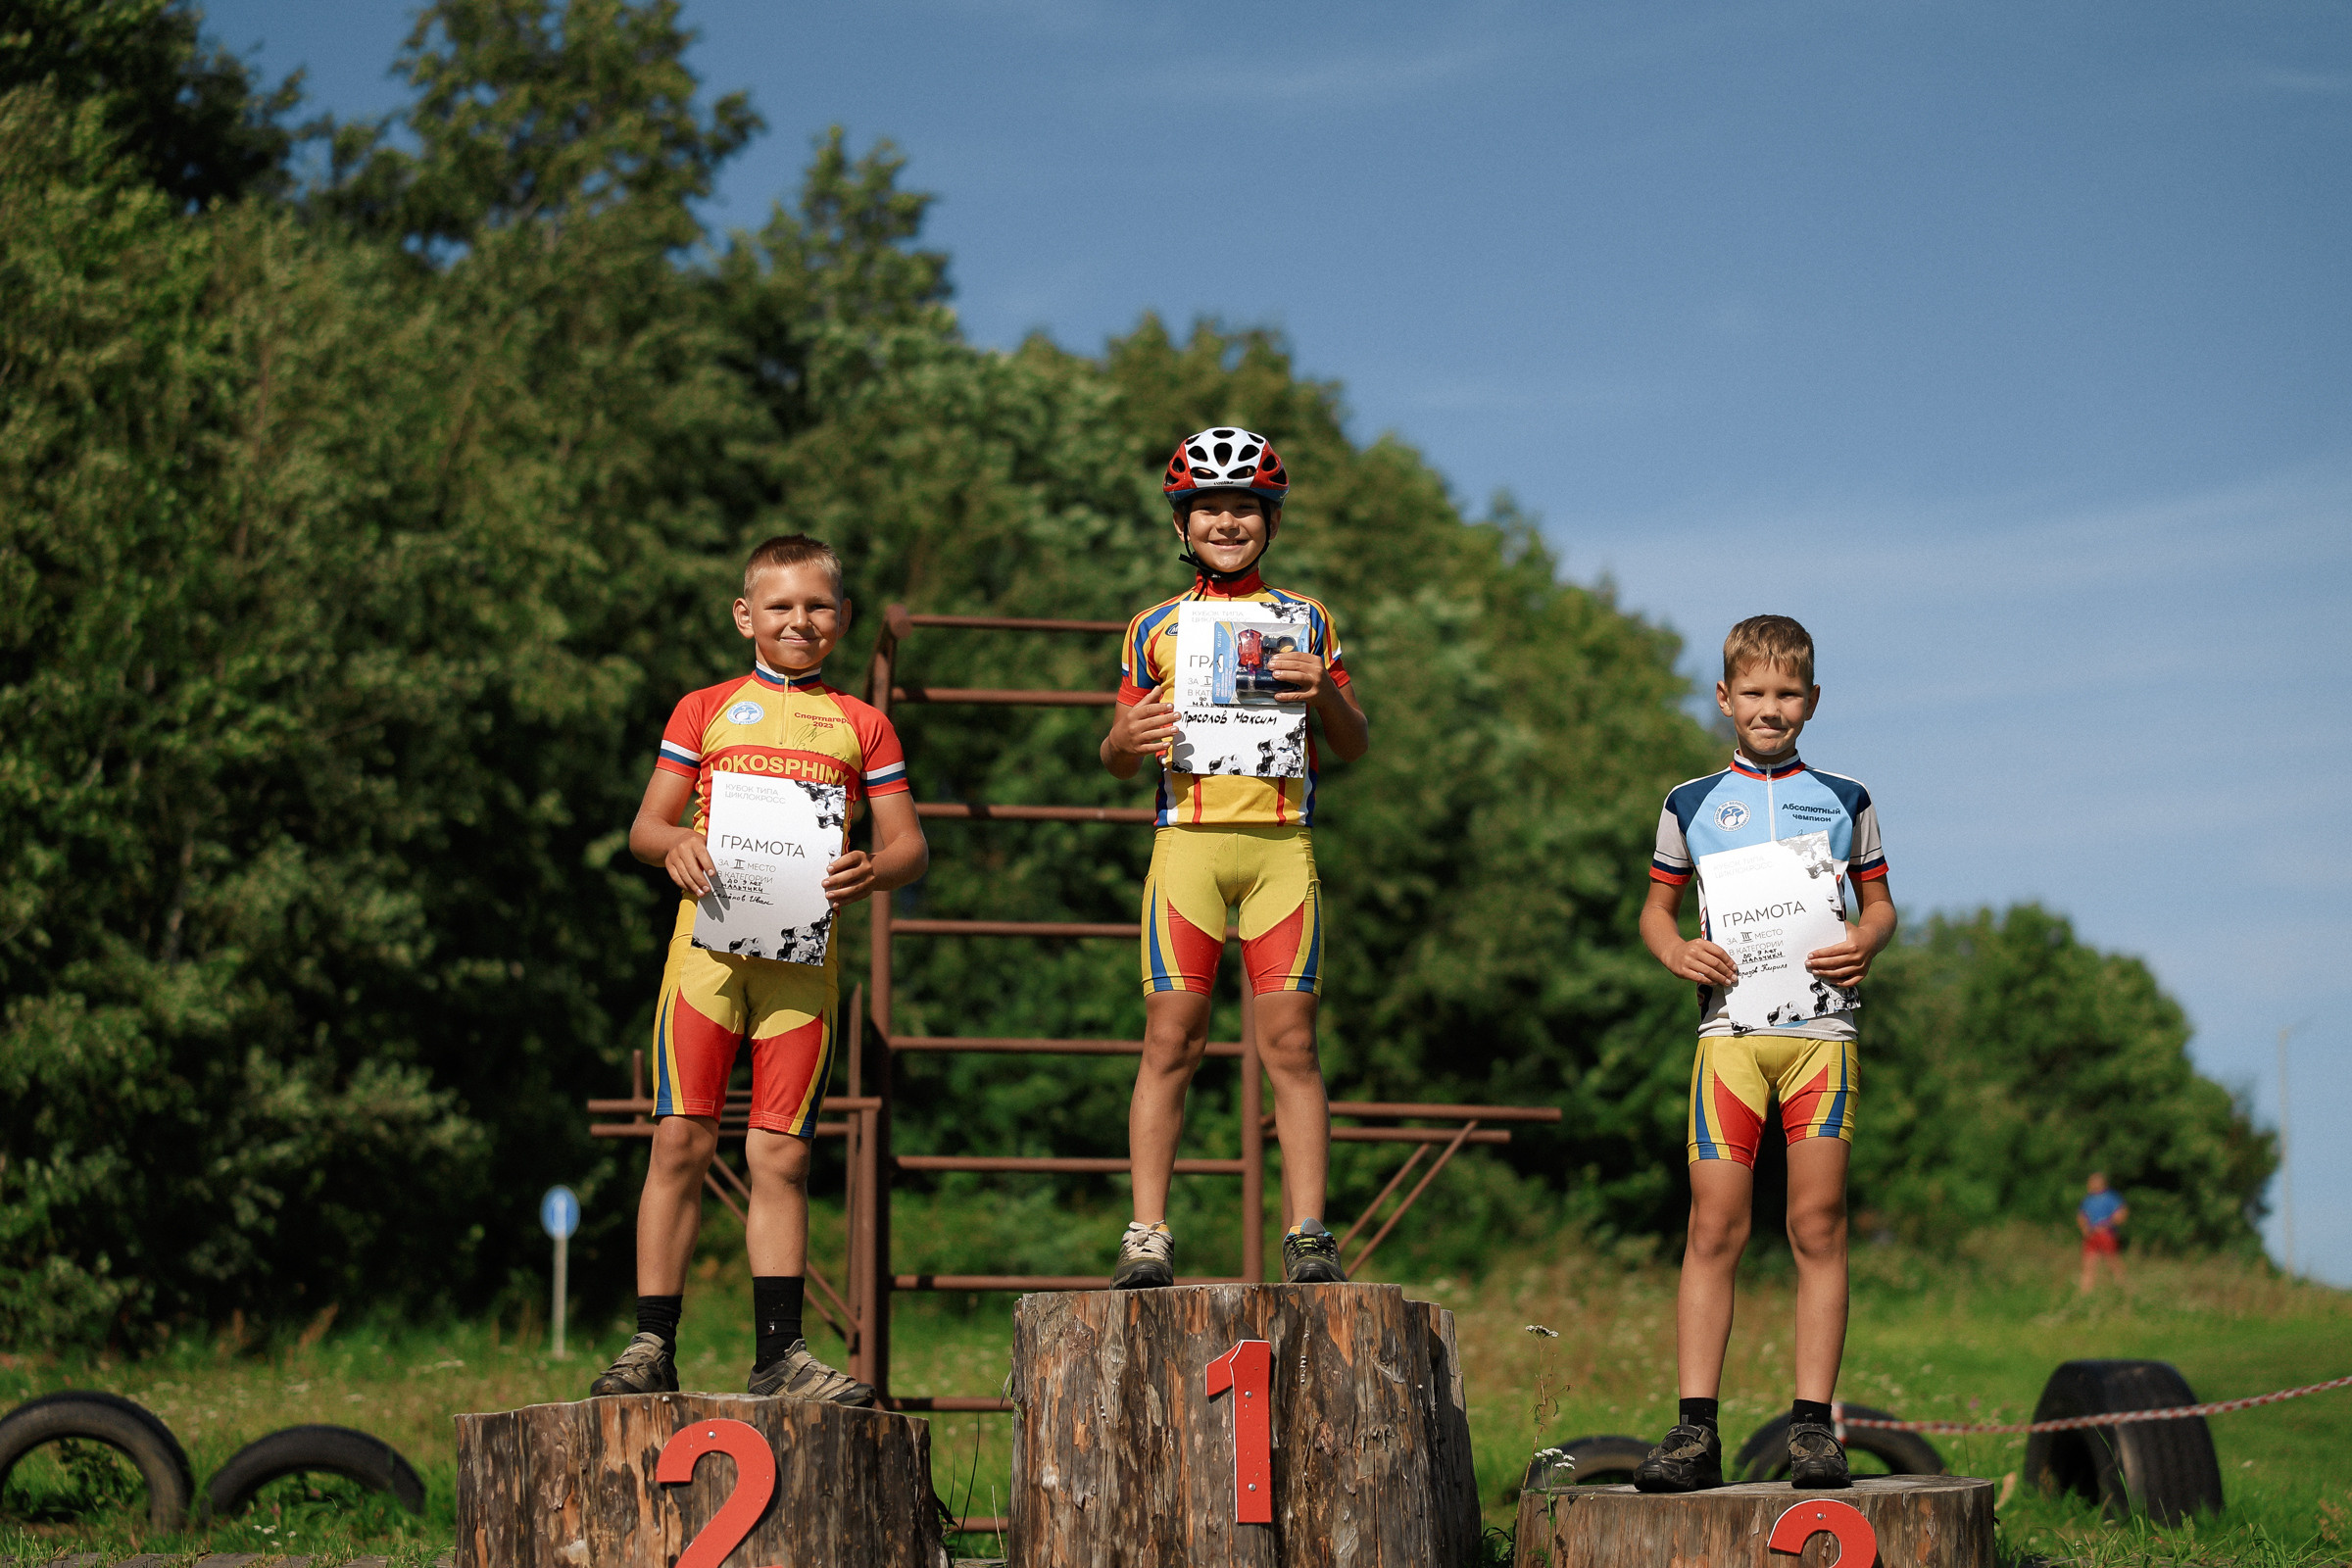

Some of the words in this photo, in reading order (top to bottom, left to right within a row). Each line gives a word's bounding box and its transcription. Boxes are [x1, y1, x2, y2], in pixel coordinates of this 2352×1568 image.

[794, 711, 851, 724] Спортлагер
[1181, 710, 1228, 728] Прасолов
[1235, 711, 1278, 726] Максим
[725, 783, 754, 793] КУБОК
[757, 786, 779, 796] ТИПА
[725, 792, 786, 805] ЦИКЛОКРОСС
[1782, 804, 1841, 815] Абсолютный
[721, 834, 806, 858] ГРАМОТА
[717, 858, 730, 867] ЗА
[747, 862, 777, 873] МЕСТО
[724, 871, 773, 884] КАТЕГОРИИ
[1723, 901, 1806, 927] ГРАМОТА
[1726, 937, 1739, 946] ЗА
[1740, 931, 1752, 942] III
[1754, 928, 1784, 940] МЕСТО
[1737, 940, 1784, 956] КАТЕГОРИИ
[1205, 1340, 1272, 1523] 1
[656, 1418, 783, 1568] 2
